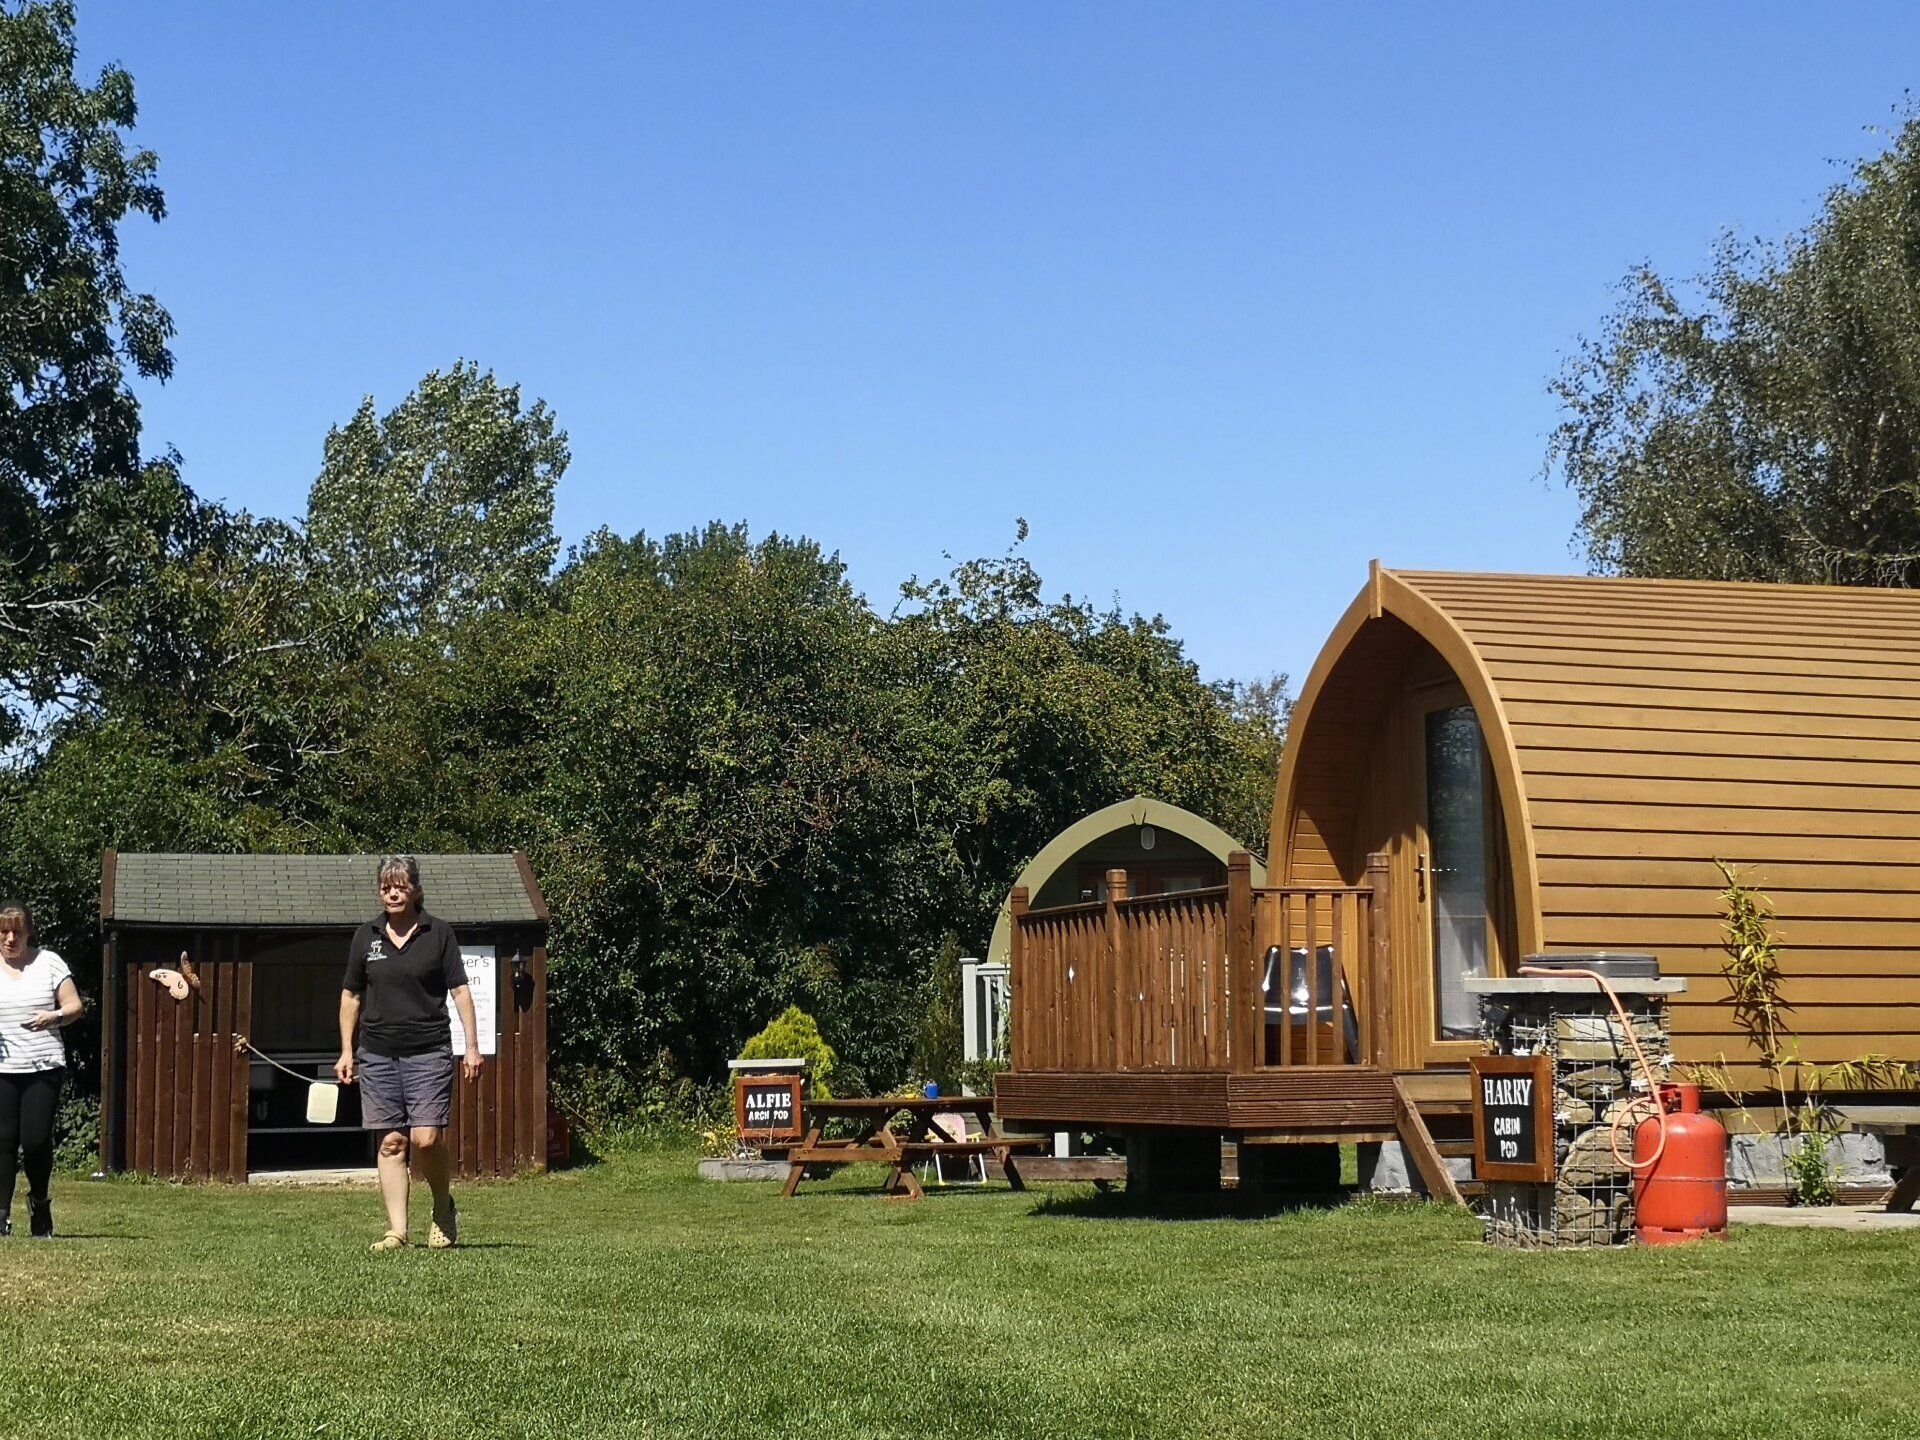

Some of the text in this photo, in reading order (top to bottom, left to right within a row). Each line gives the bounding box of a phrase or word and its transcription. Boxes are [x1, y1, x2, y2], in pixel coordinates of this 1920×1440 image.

[745, 1093, 792, 1108] ALFIE
[1483, 1079, 1533, 1106] HARRY
[748, 1110, 789, 1121] ARCH POD
[1494, 1117, 1520, 1136] CABIN
[1500, 1140, 1518, 1159] POD
